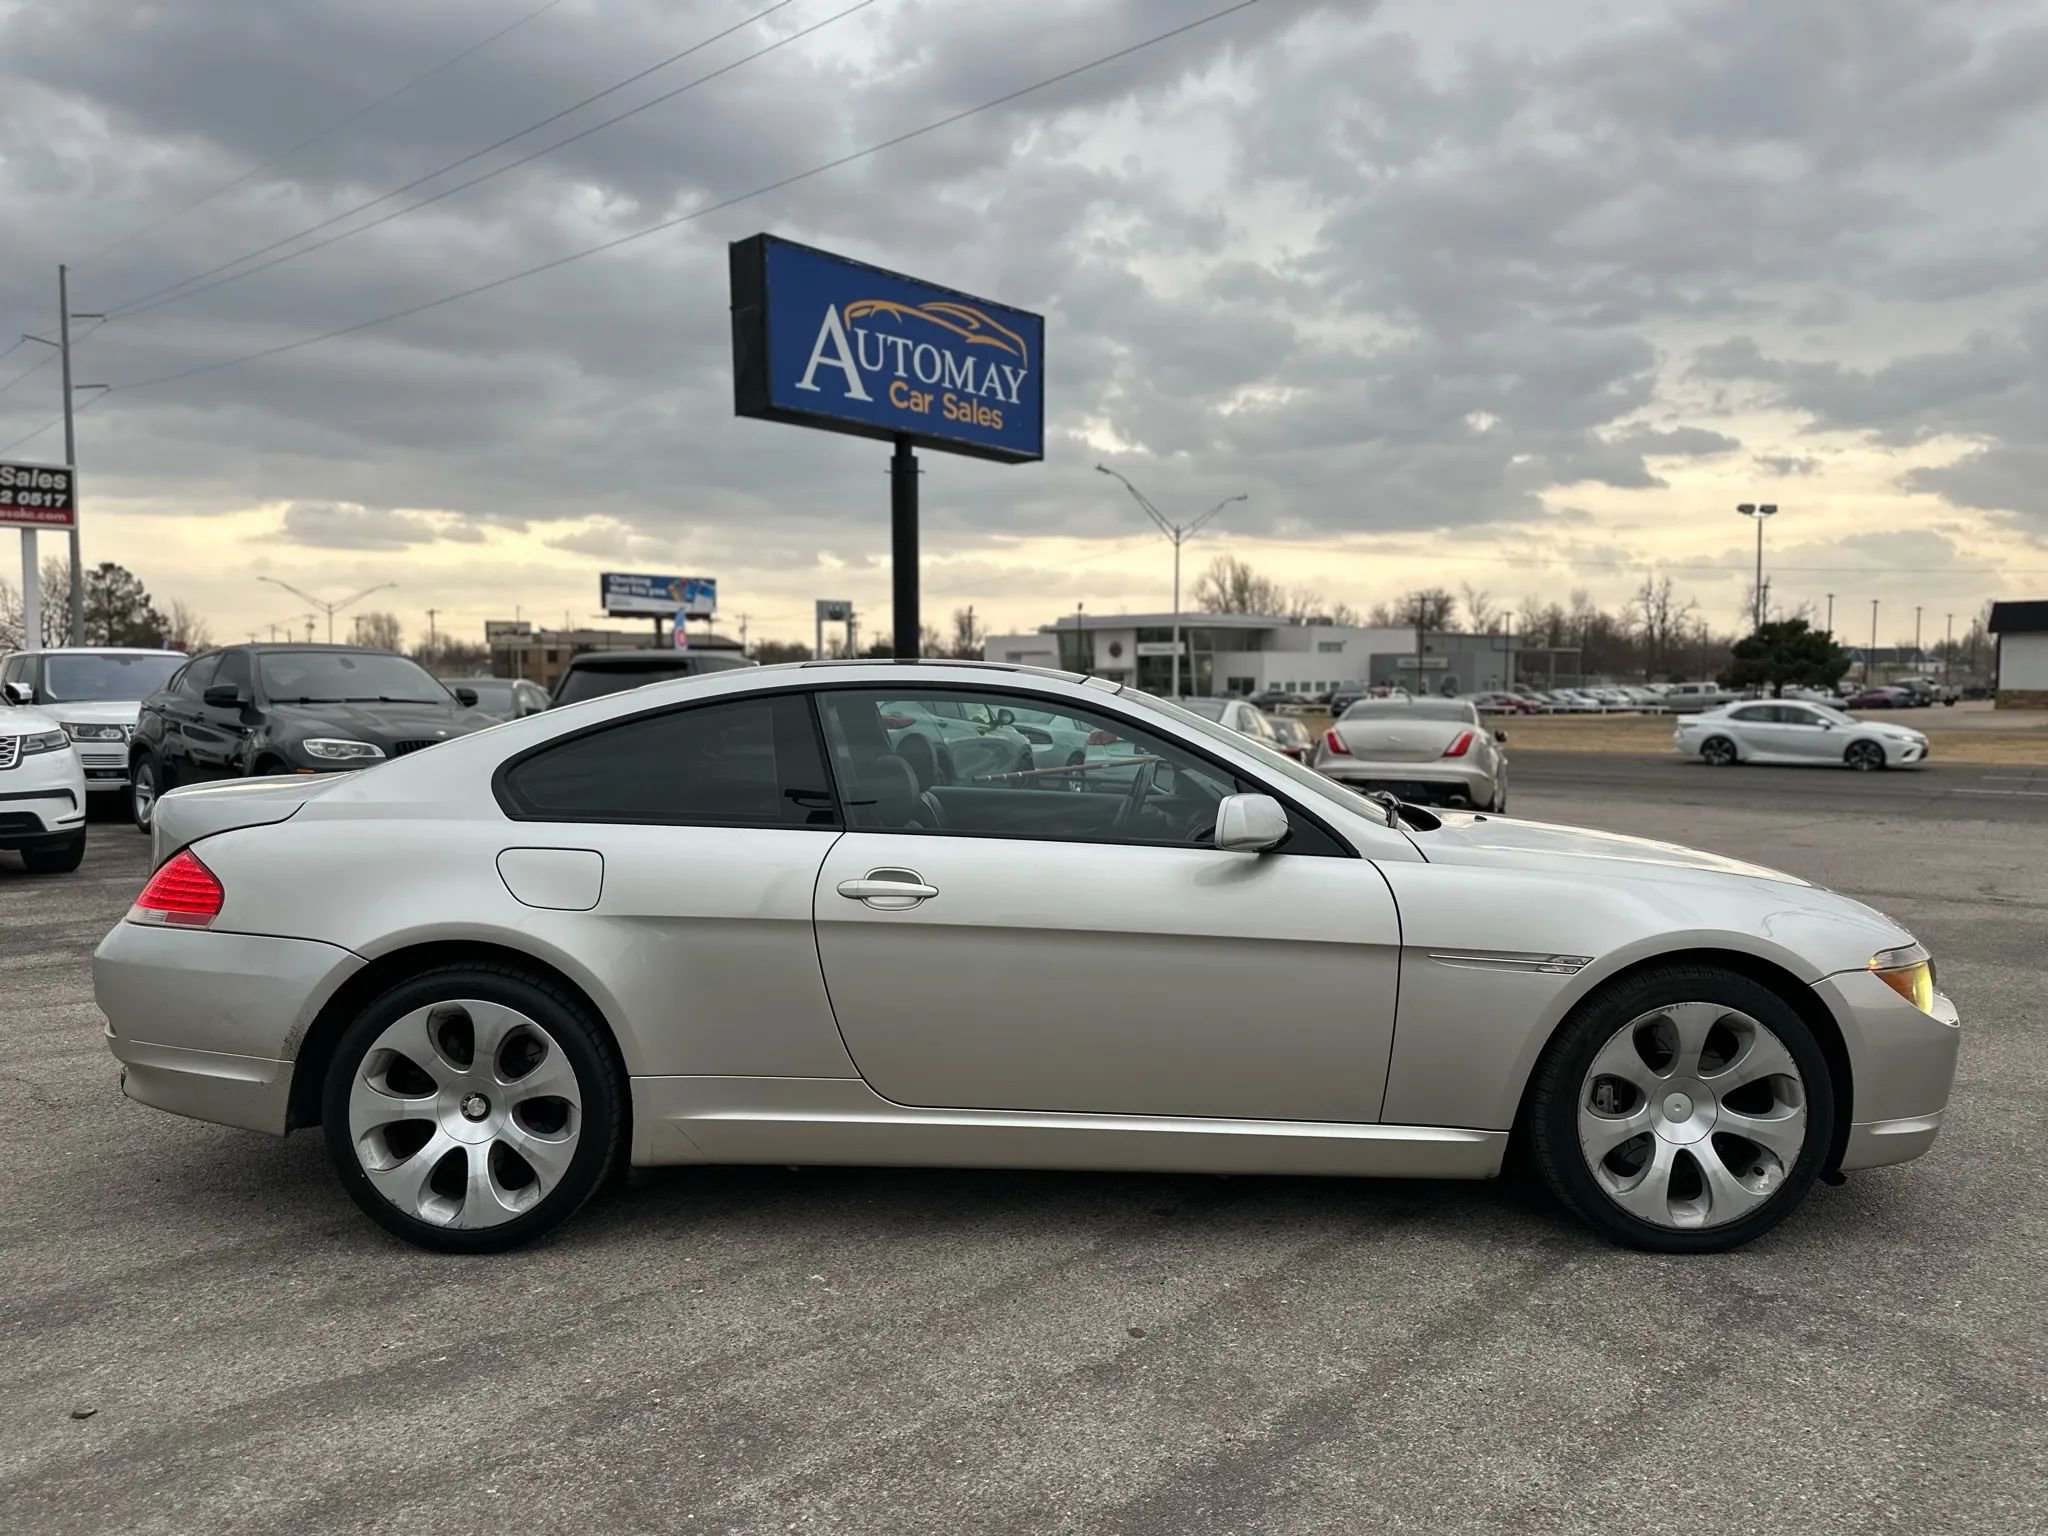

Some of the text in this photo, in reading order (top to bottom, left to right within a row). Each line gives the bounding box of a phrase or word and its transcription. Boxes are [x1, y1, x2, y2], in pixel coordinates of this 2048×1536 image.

[889, 380, 1004, 430] Car Sales
[0, 466, 67, 490] Sales
[17, 491, 67, 507] 0517
